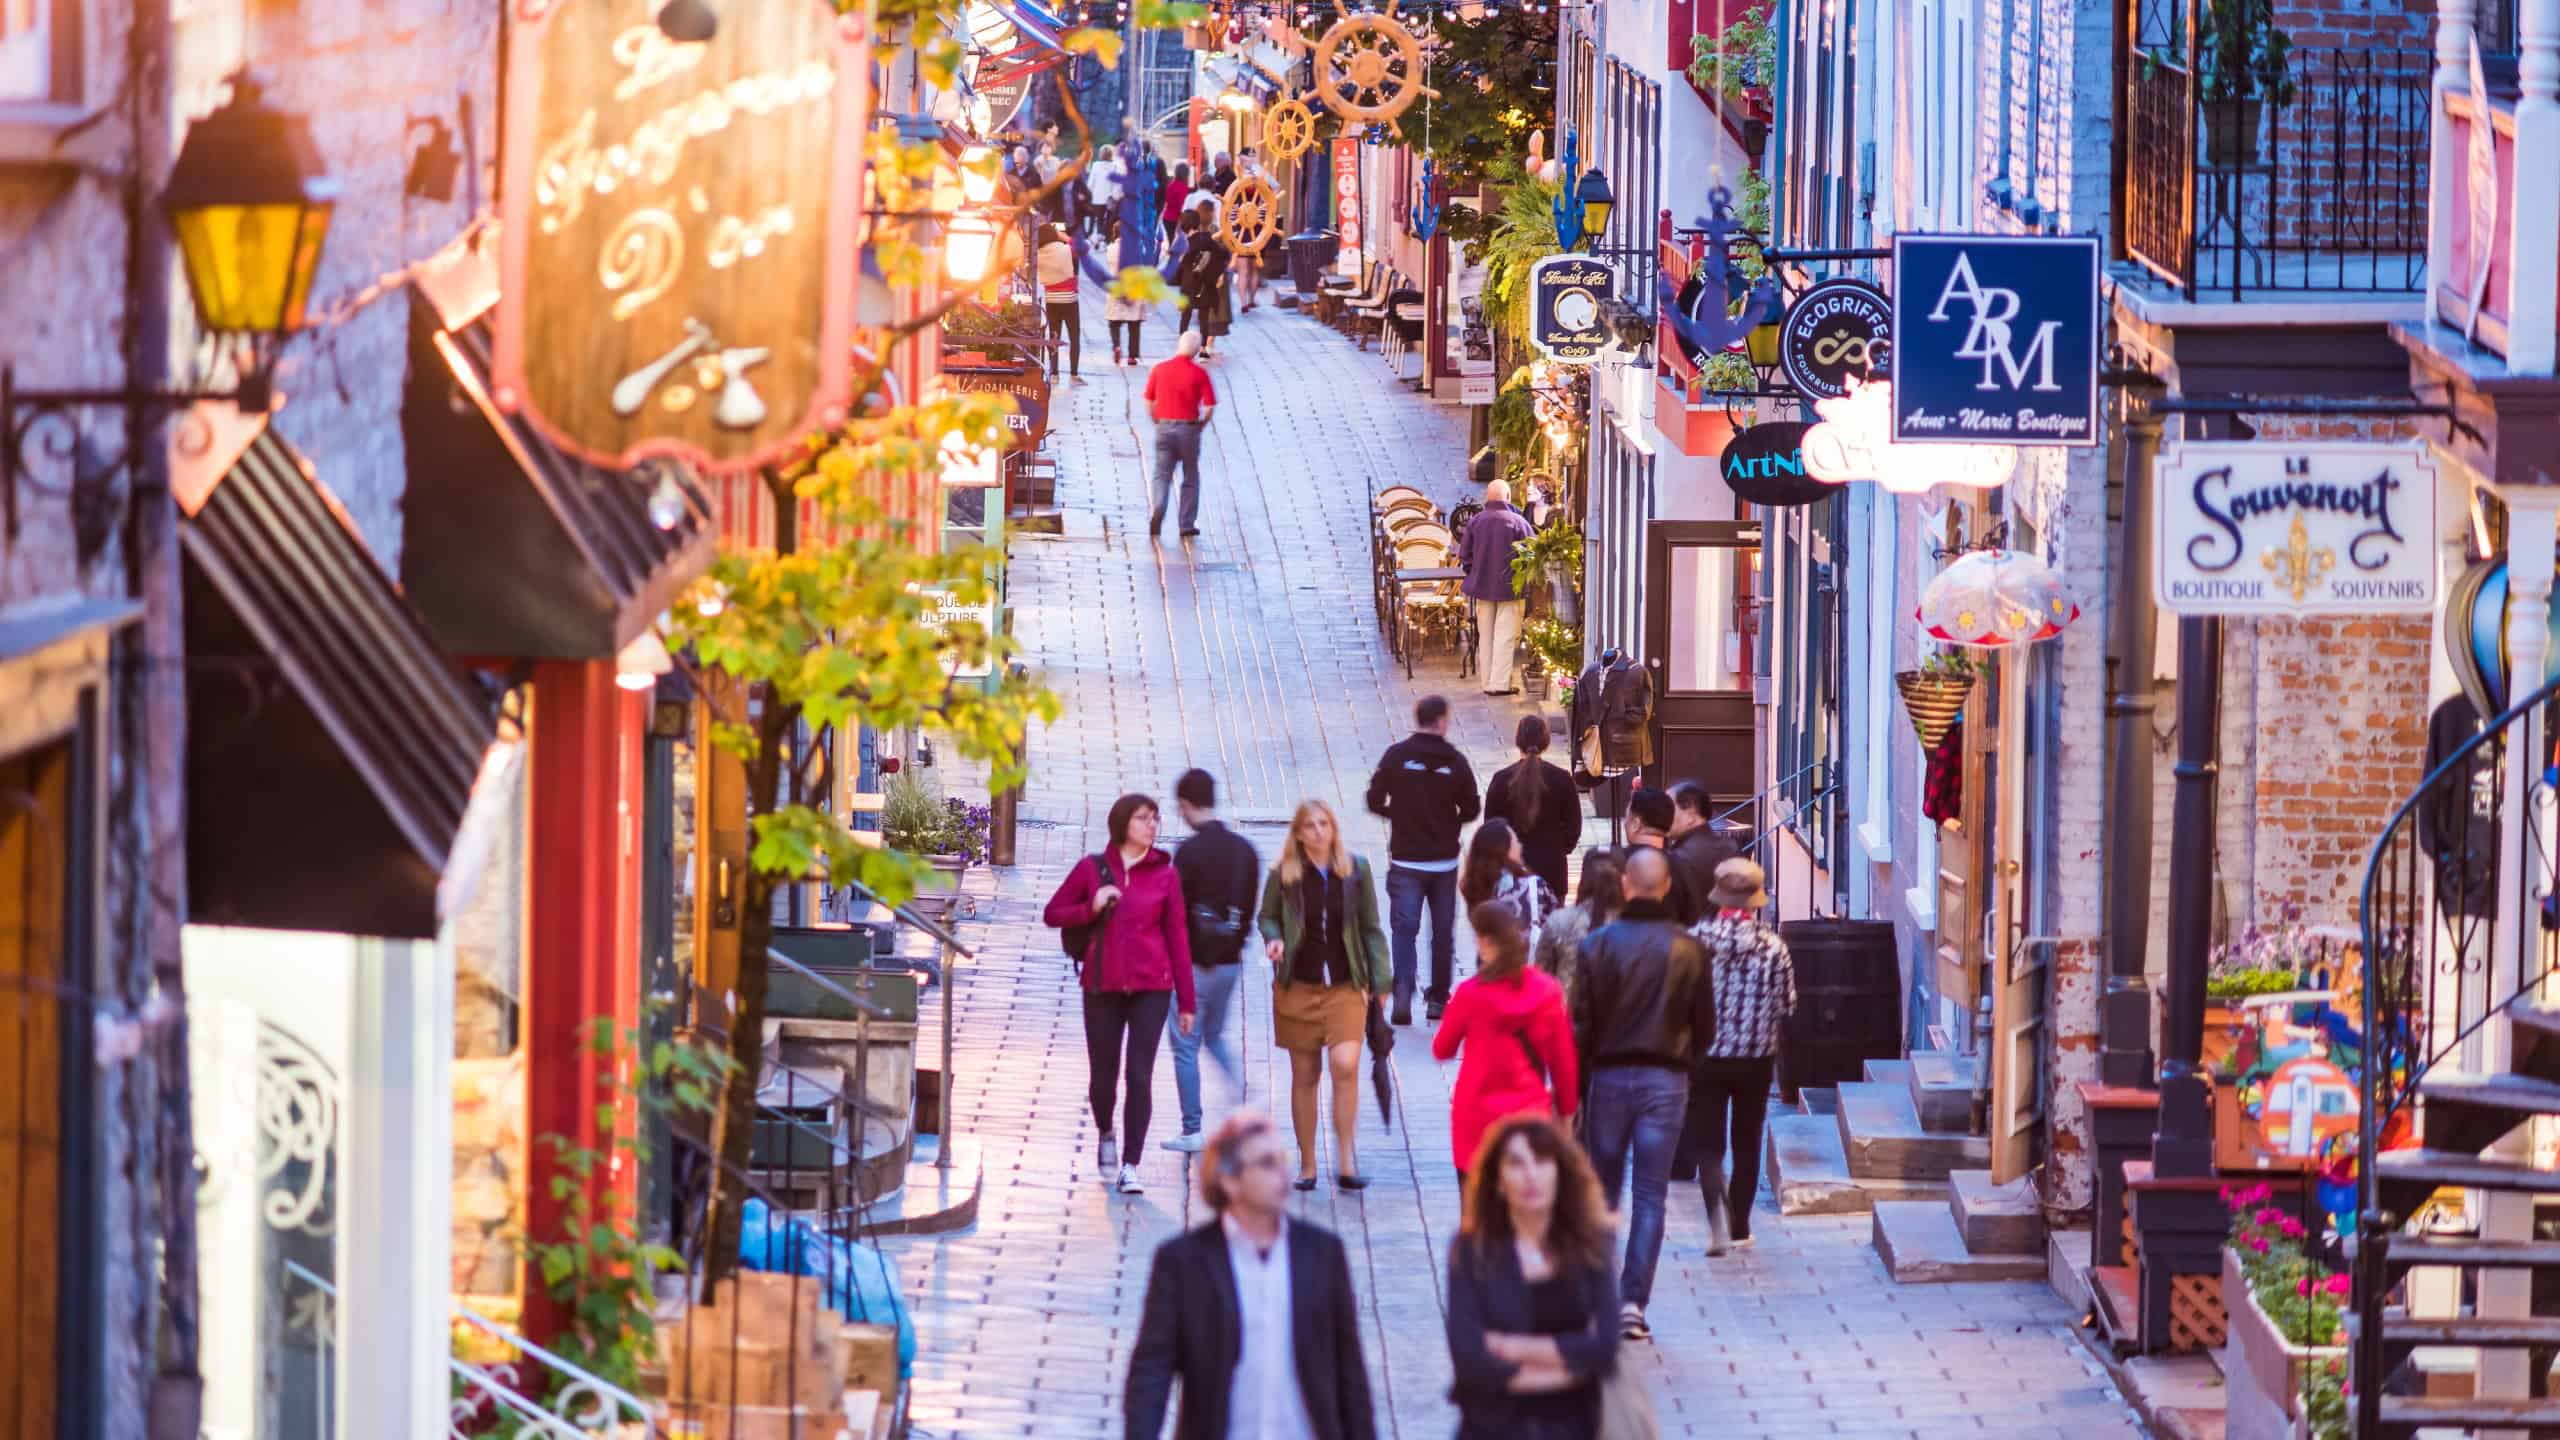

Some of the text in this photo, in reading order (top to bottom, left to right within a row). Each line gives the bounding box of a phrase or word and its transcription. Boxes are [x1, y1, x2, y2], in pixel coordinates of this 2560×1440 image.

[1798, 296, 1889, 339] ECOGRIFFE
[1796, 354, 1843, 394] FOURRURE
[2016, 407, 2086, 437] Boutique
[1727, 448, 1804, 479] ArtNi
[2284, 456, 2309, 475] LE
[2172, 580, 2426, 600] BOUTIQUE SOUVENIRS
